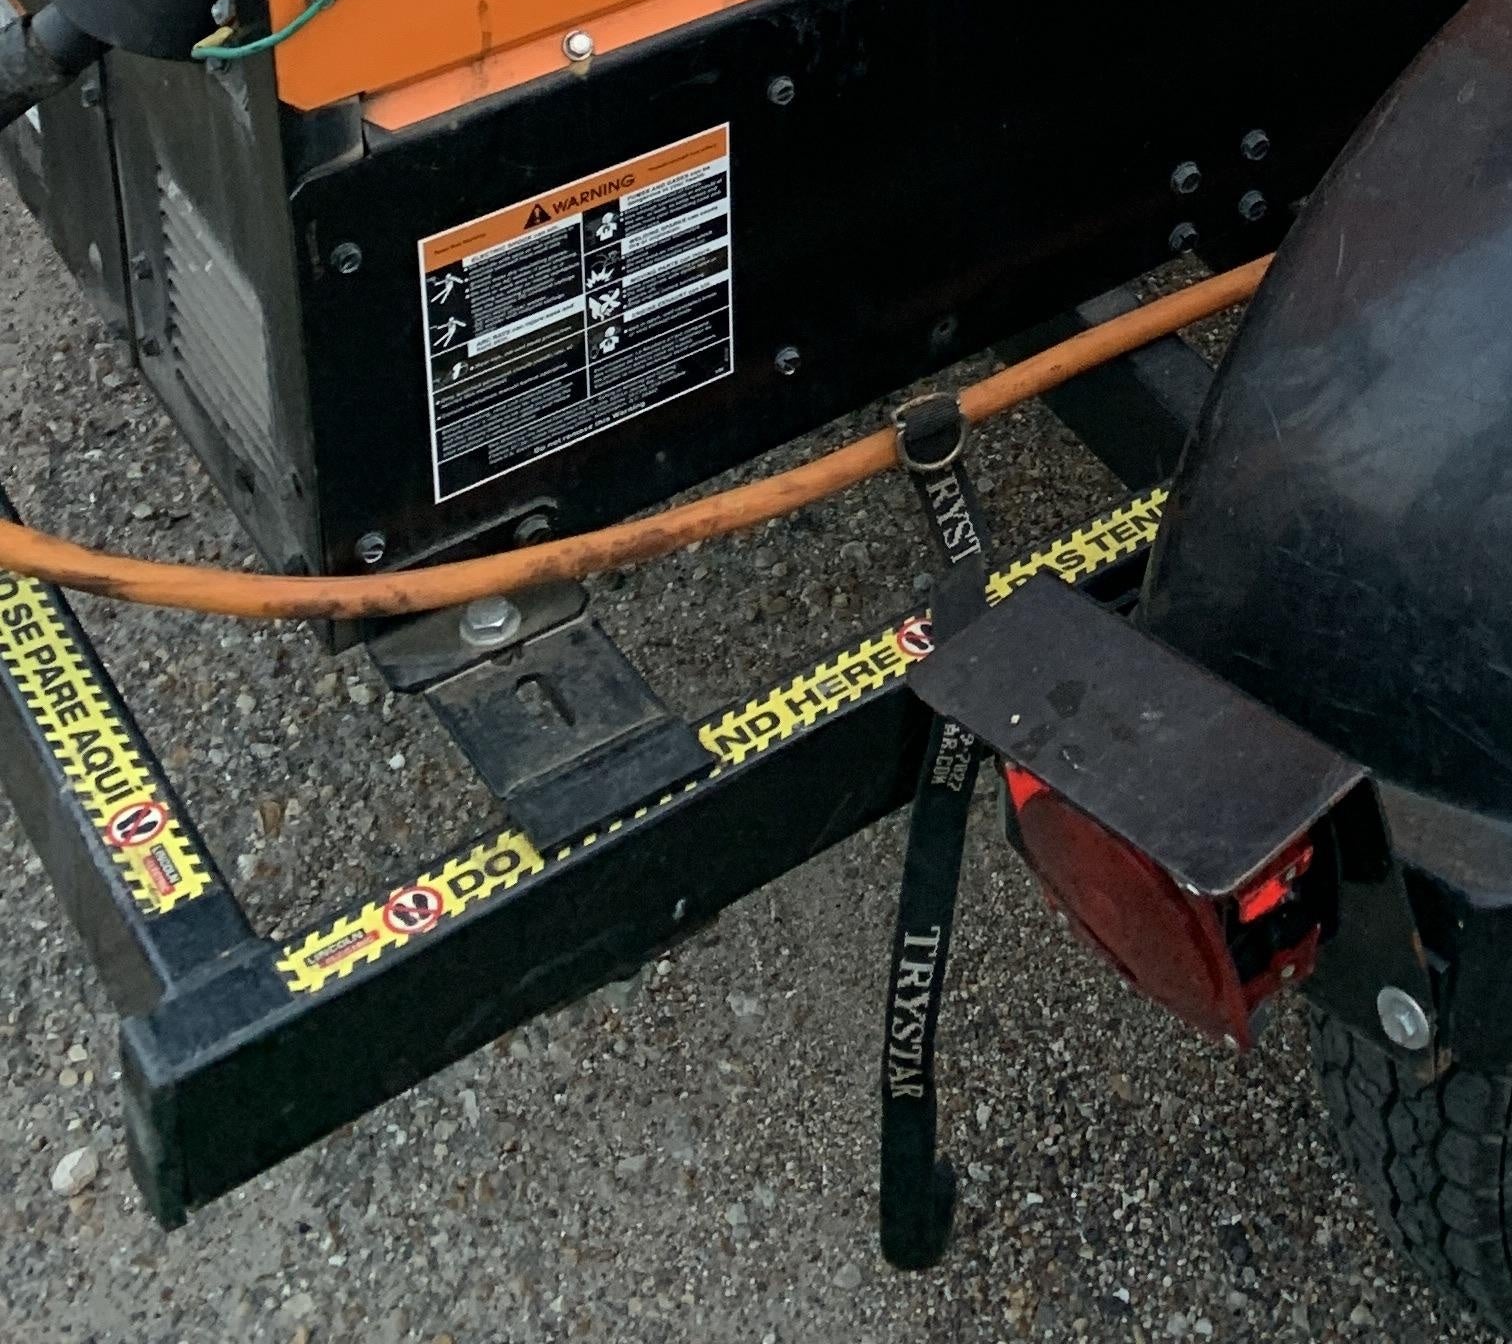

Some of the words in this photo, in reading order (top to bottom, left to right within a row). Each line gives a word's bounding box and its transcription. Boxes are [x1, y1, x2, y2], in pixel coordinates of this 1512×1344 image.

[552, 173, 636, 215] WARNING
[926, 474, 982, 564] RYST
[6, 602, 45, 646] SE
[24, 643, 90, 727] PARE
[785, 645, 902, 716] HERE
[68, 728, 144, 806] AQUÍ
[447, 848, 521, 899] DO
[889, 925, 941, 1099] TRYSTAR
